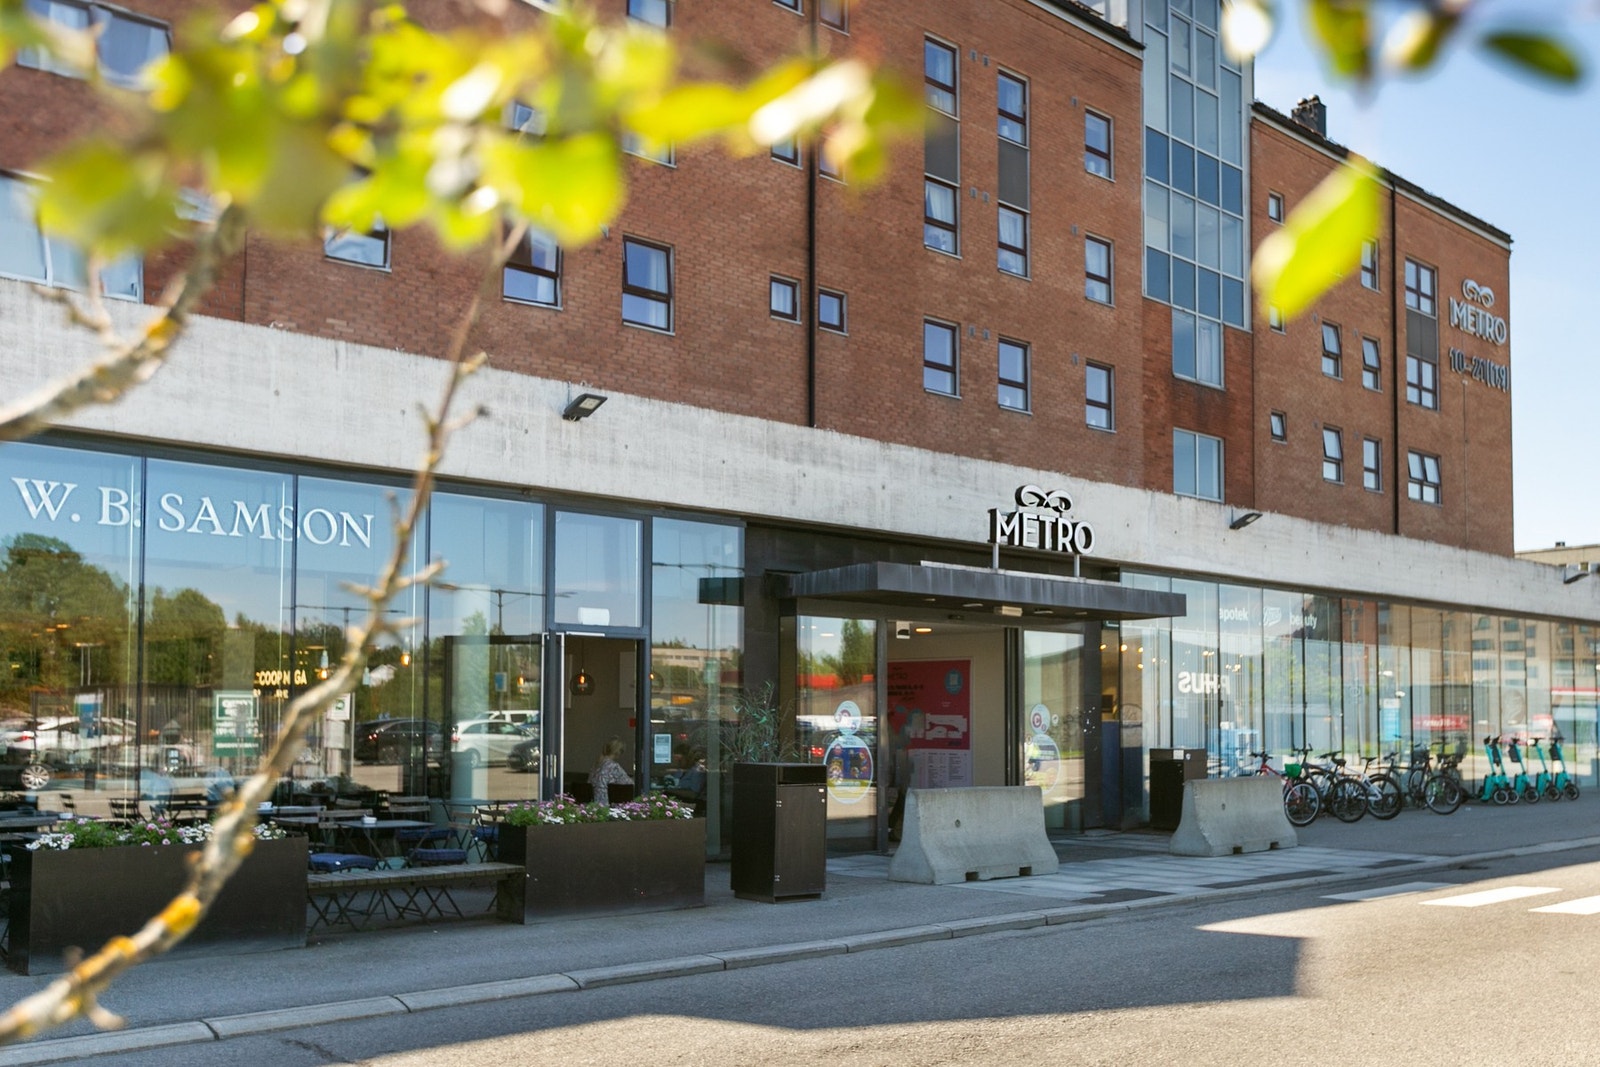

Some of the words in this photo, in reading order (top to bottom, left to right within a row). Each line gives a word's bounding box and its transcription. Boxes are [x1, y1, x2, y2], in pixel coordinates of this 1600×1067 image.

[1449, 296, 1507, 346] METRO
[11, 477, 80, 523] W.
[158, 492, 374, 549] SAMSON
[990, 508, 1096, 555] METRO
[1219, 608, 1248, 622] apotek
[259, 670, 283, 686] COOP
[283, 669, 307, 685] MGA
